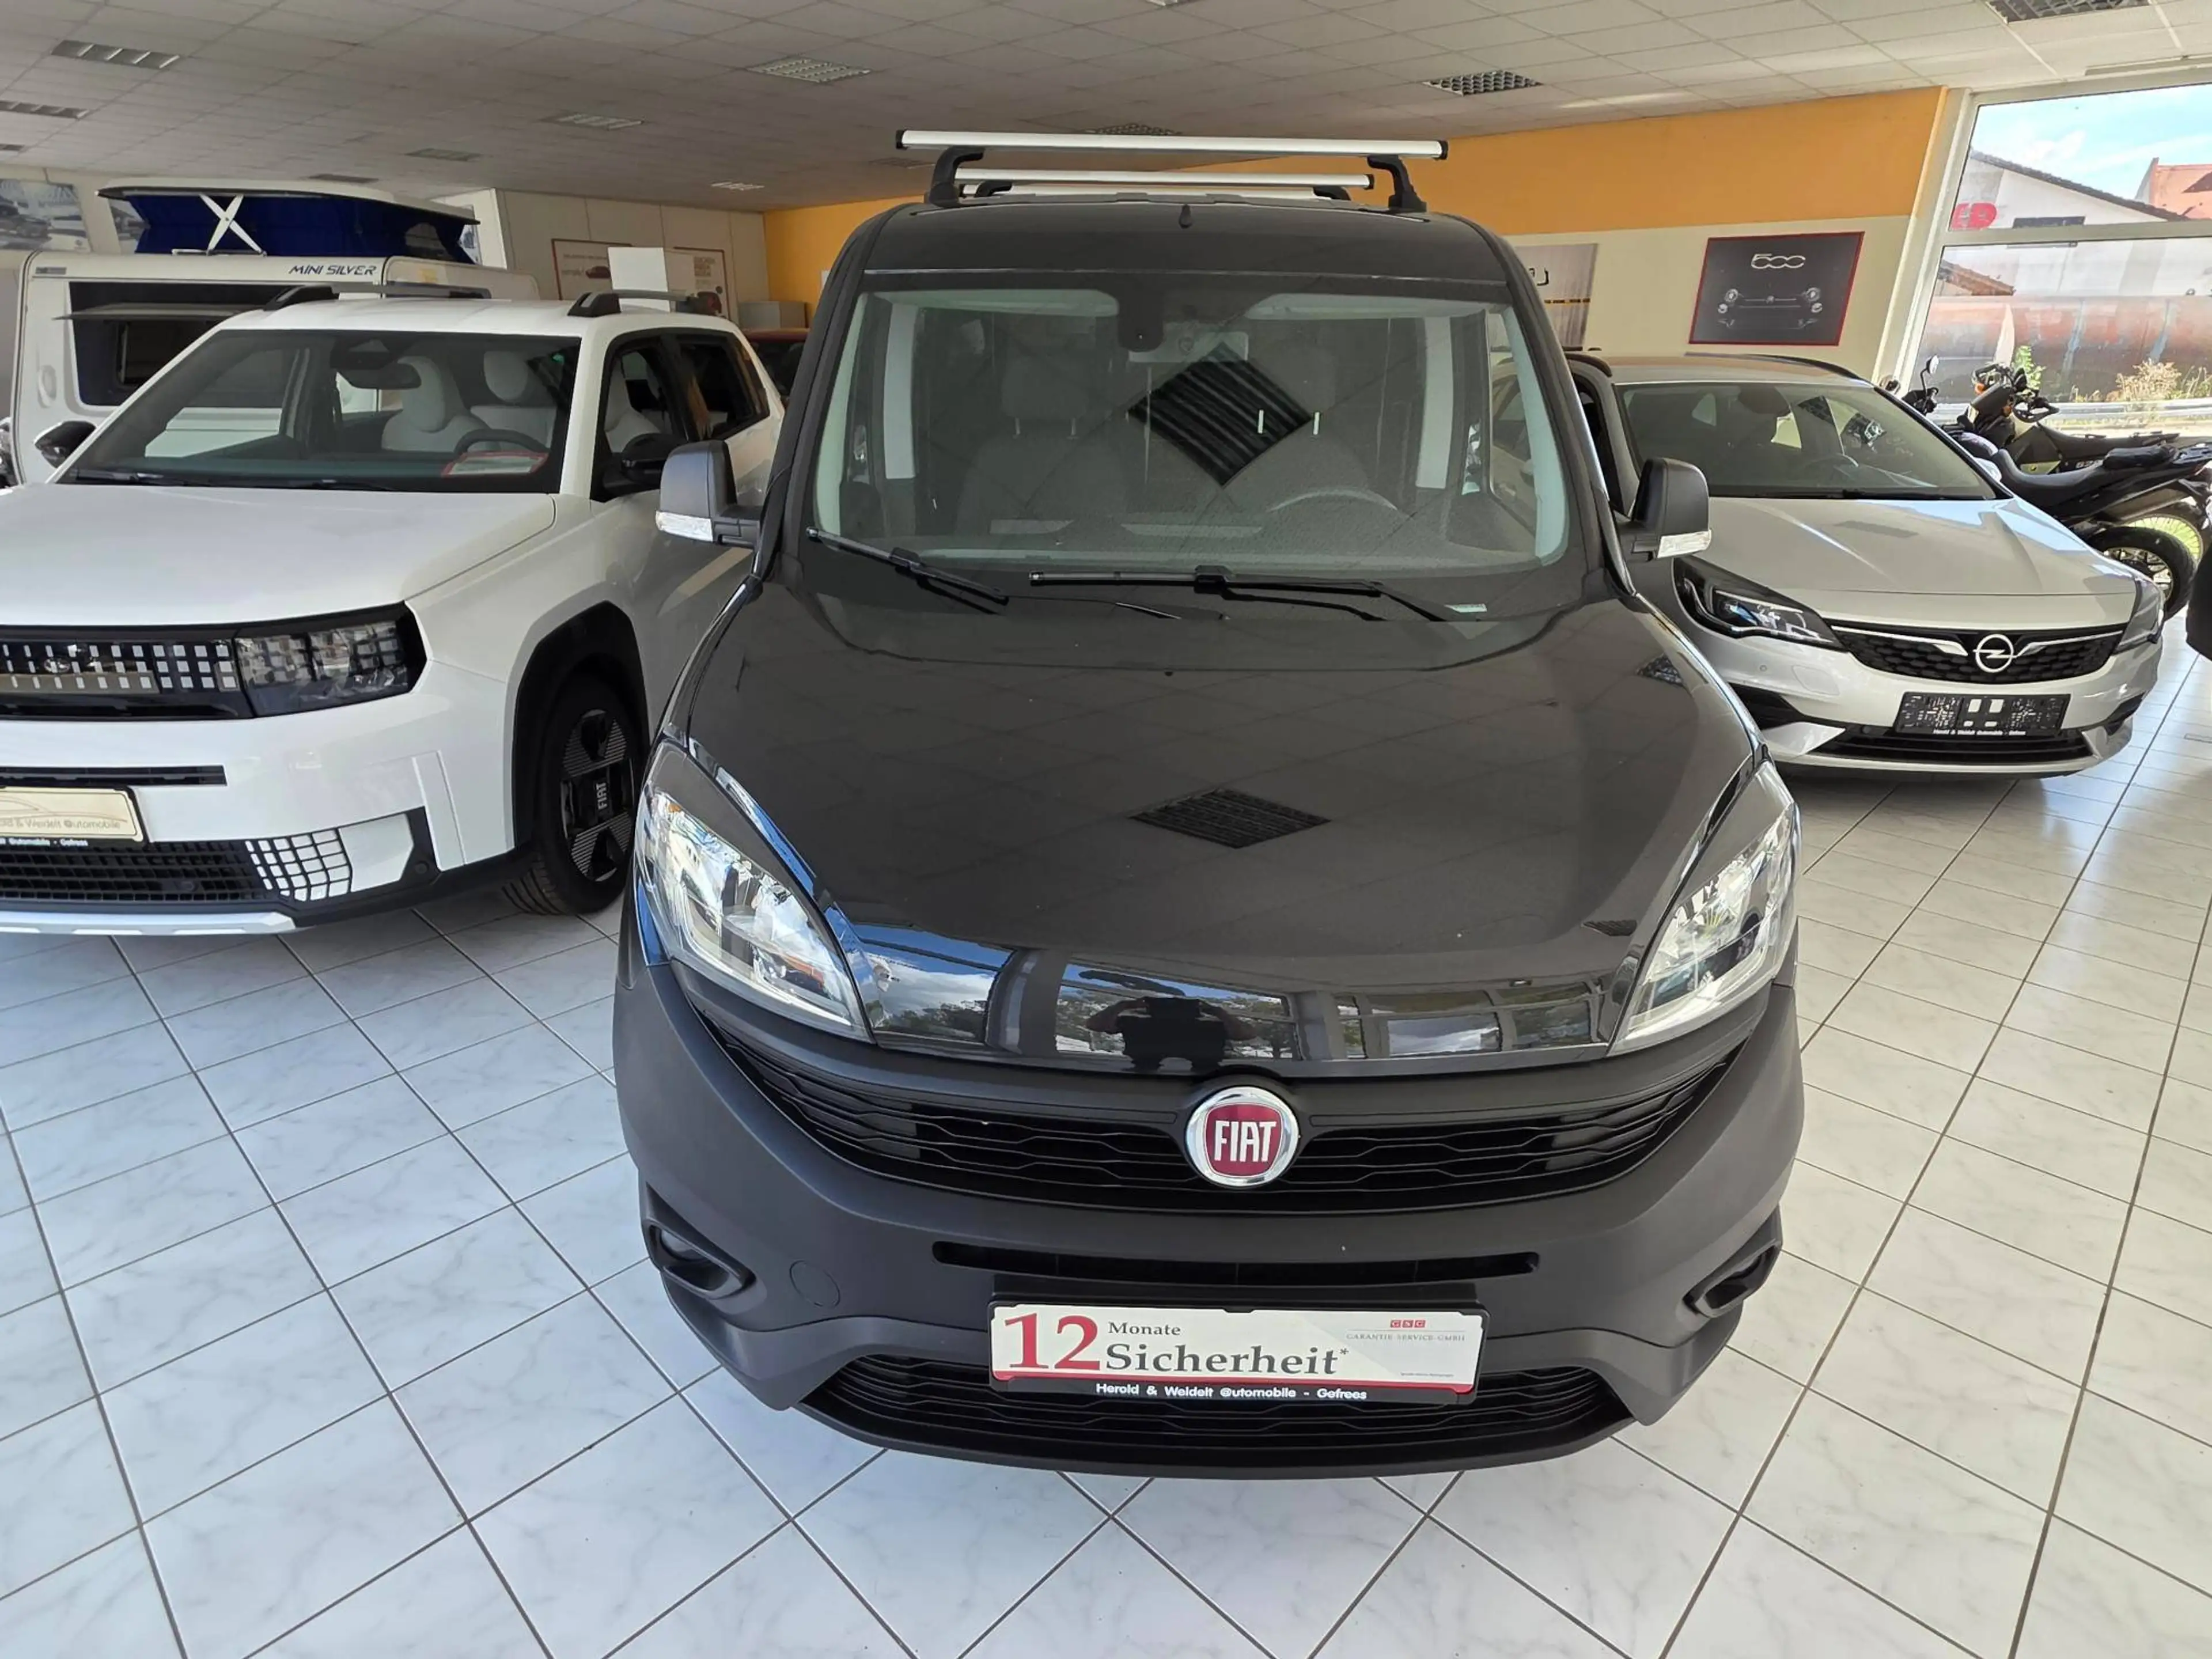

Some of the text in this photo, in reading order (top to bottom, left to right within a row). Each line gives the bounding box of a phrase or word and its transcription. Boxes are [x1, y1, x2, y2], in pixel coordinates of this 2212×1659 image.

[1751, 253, 1806, 269] 500
[289, 265, 376, 275] MINI SILVER
[596, 783, 607, 809] FIAT
[1214, 1120, 1277, 1162] FIAT
[1108, 1322, 1181, 1336] Monate
[1005, 1312, 1100, 1371] 12
[1096, 1383, 1139, 1395] Herold
[1146, 1385, 1157, 1396] &
